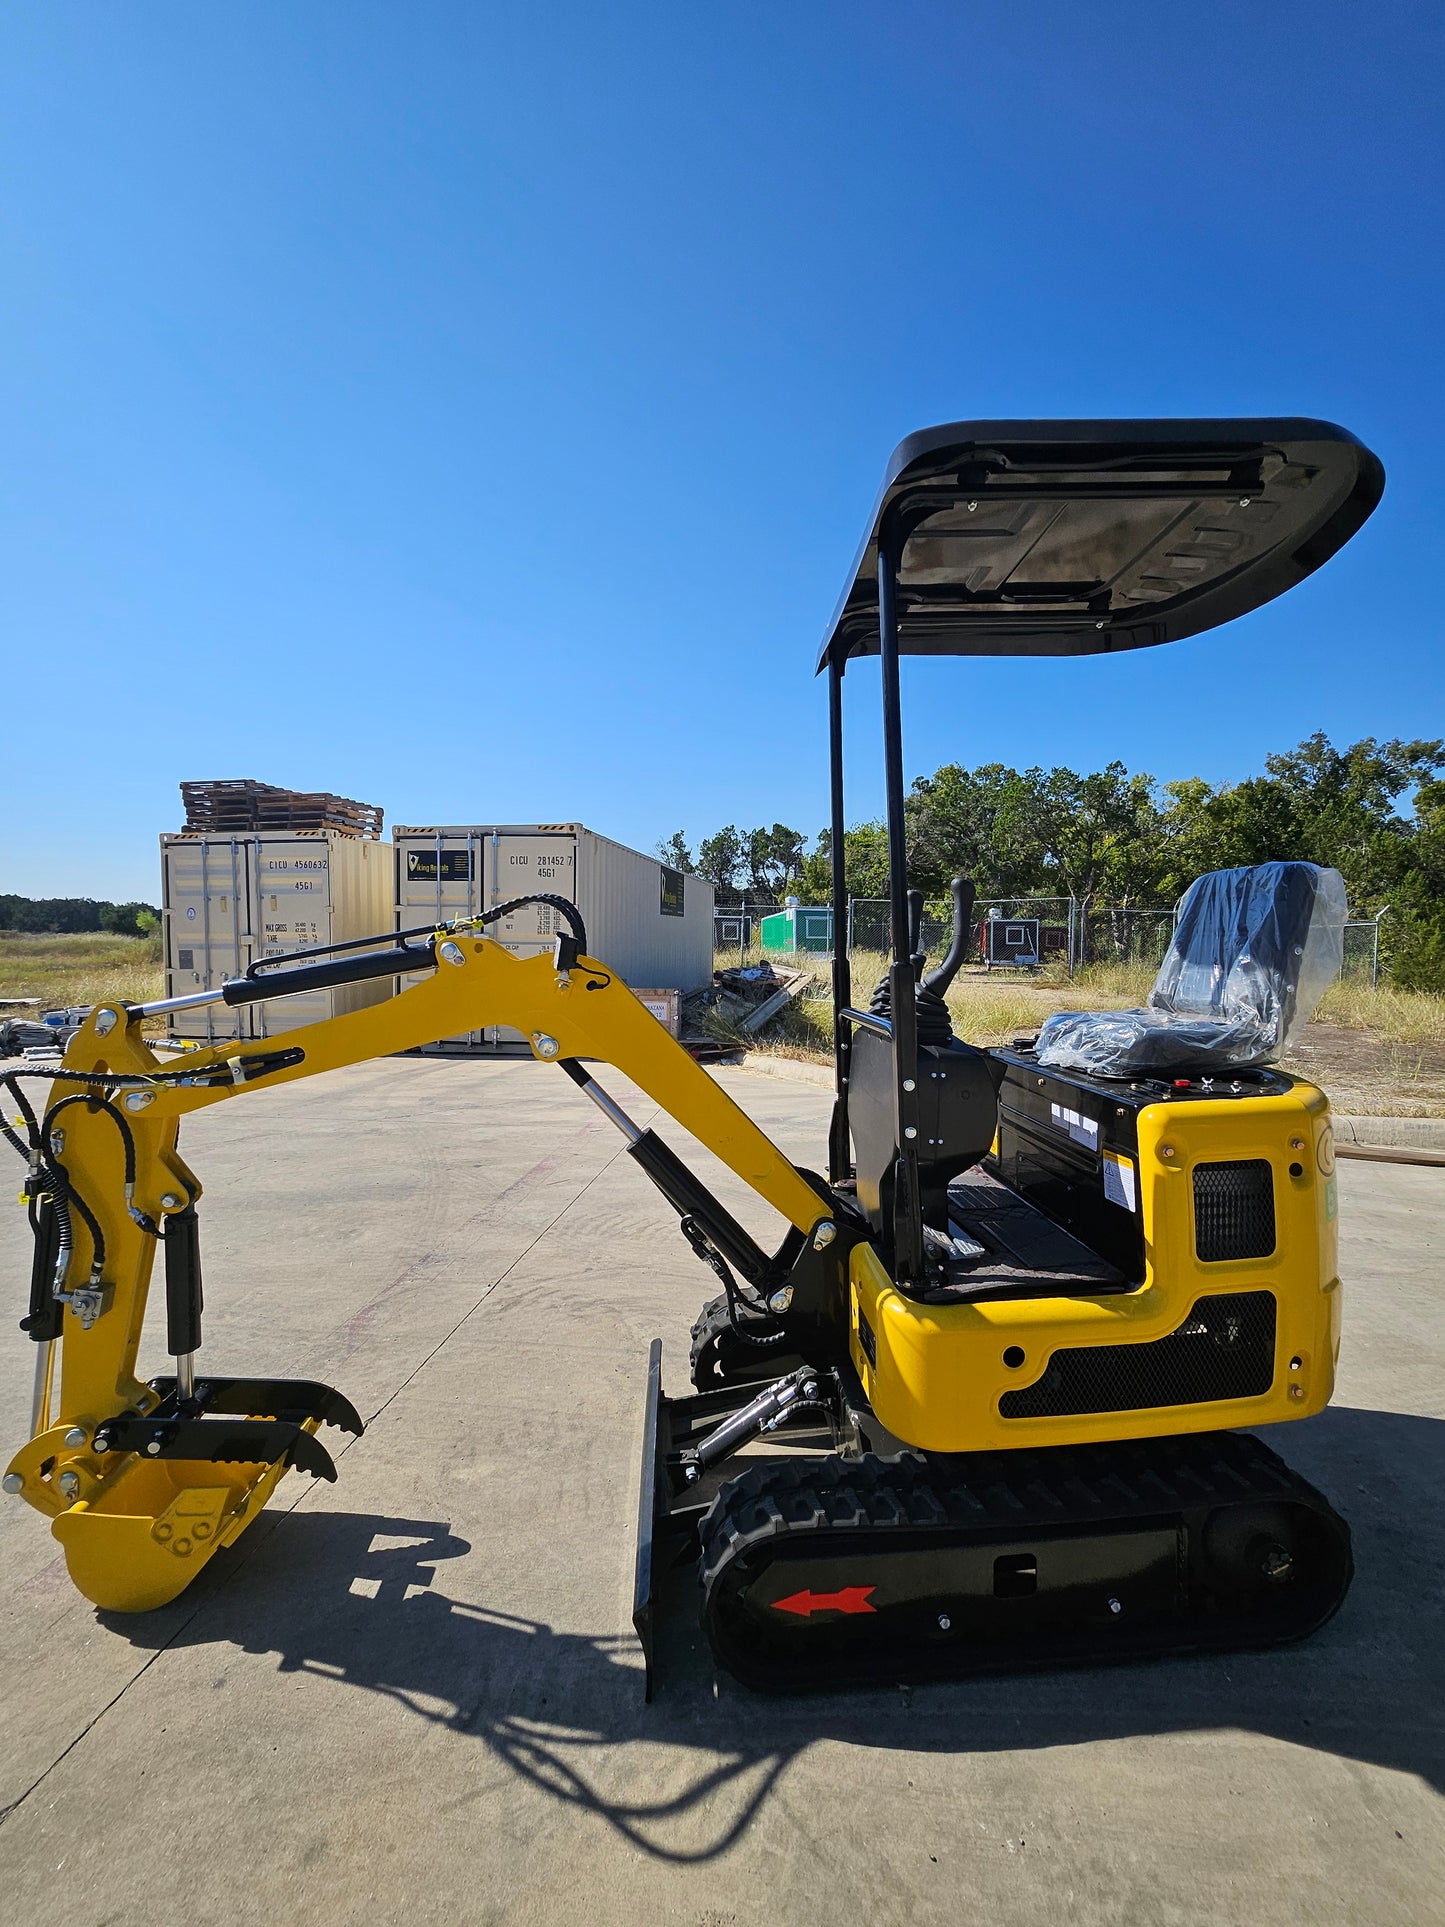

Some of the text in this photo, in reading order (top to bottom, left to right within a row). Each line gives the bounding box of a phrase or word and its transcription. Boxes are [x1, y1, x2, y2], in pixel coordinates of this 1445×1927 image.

[269, 861, 327, 869] CICU 4560632
[510, 856, 572, 865] CICU 281452 7
[538, 868, 555, 877] 45G1
[265, 923, 275, 932] MAX
[275, 923, 288, 932] GROSS
